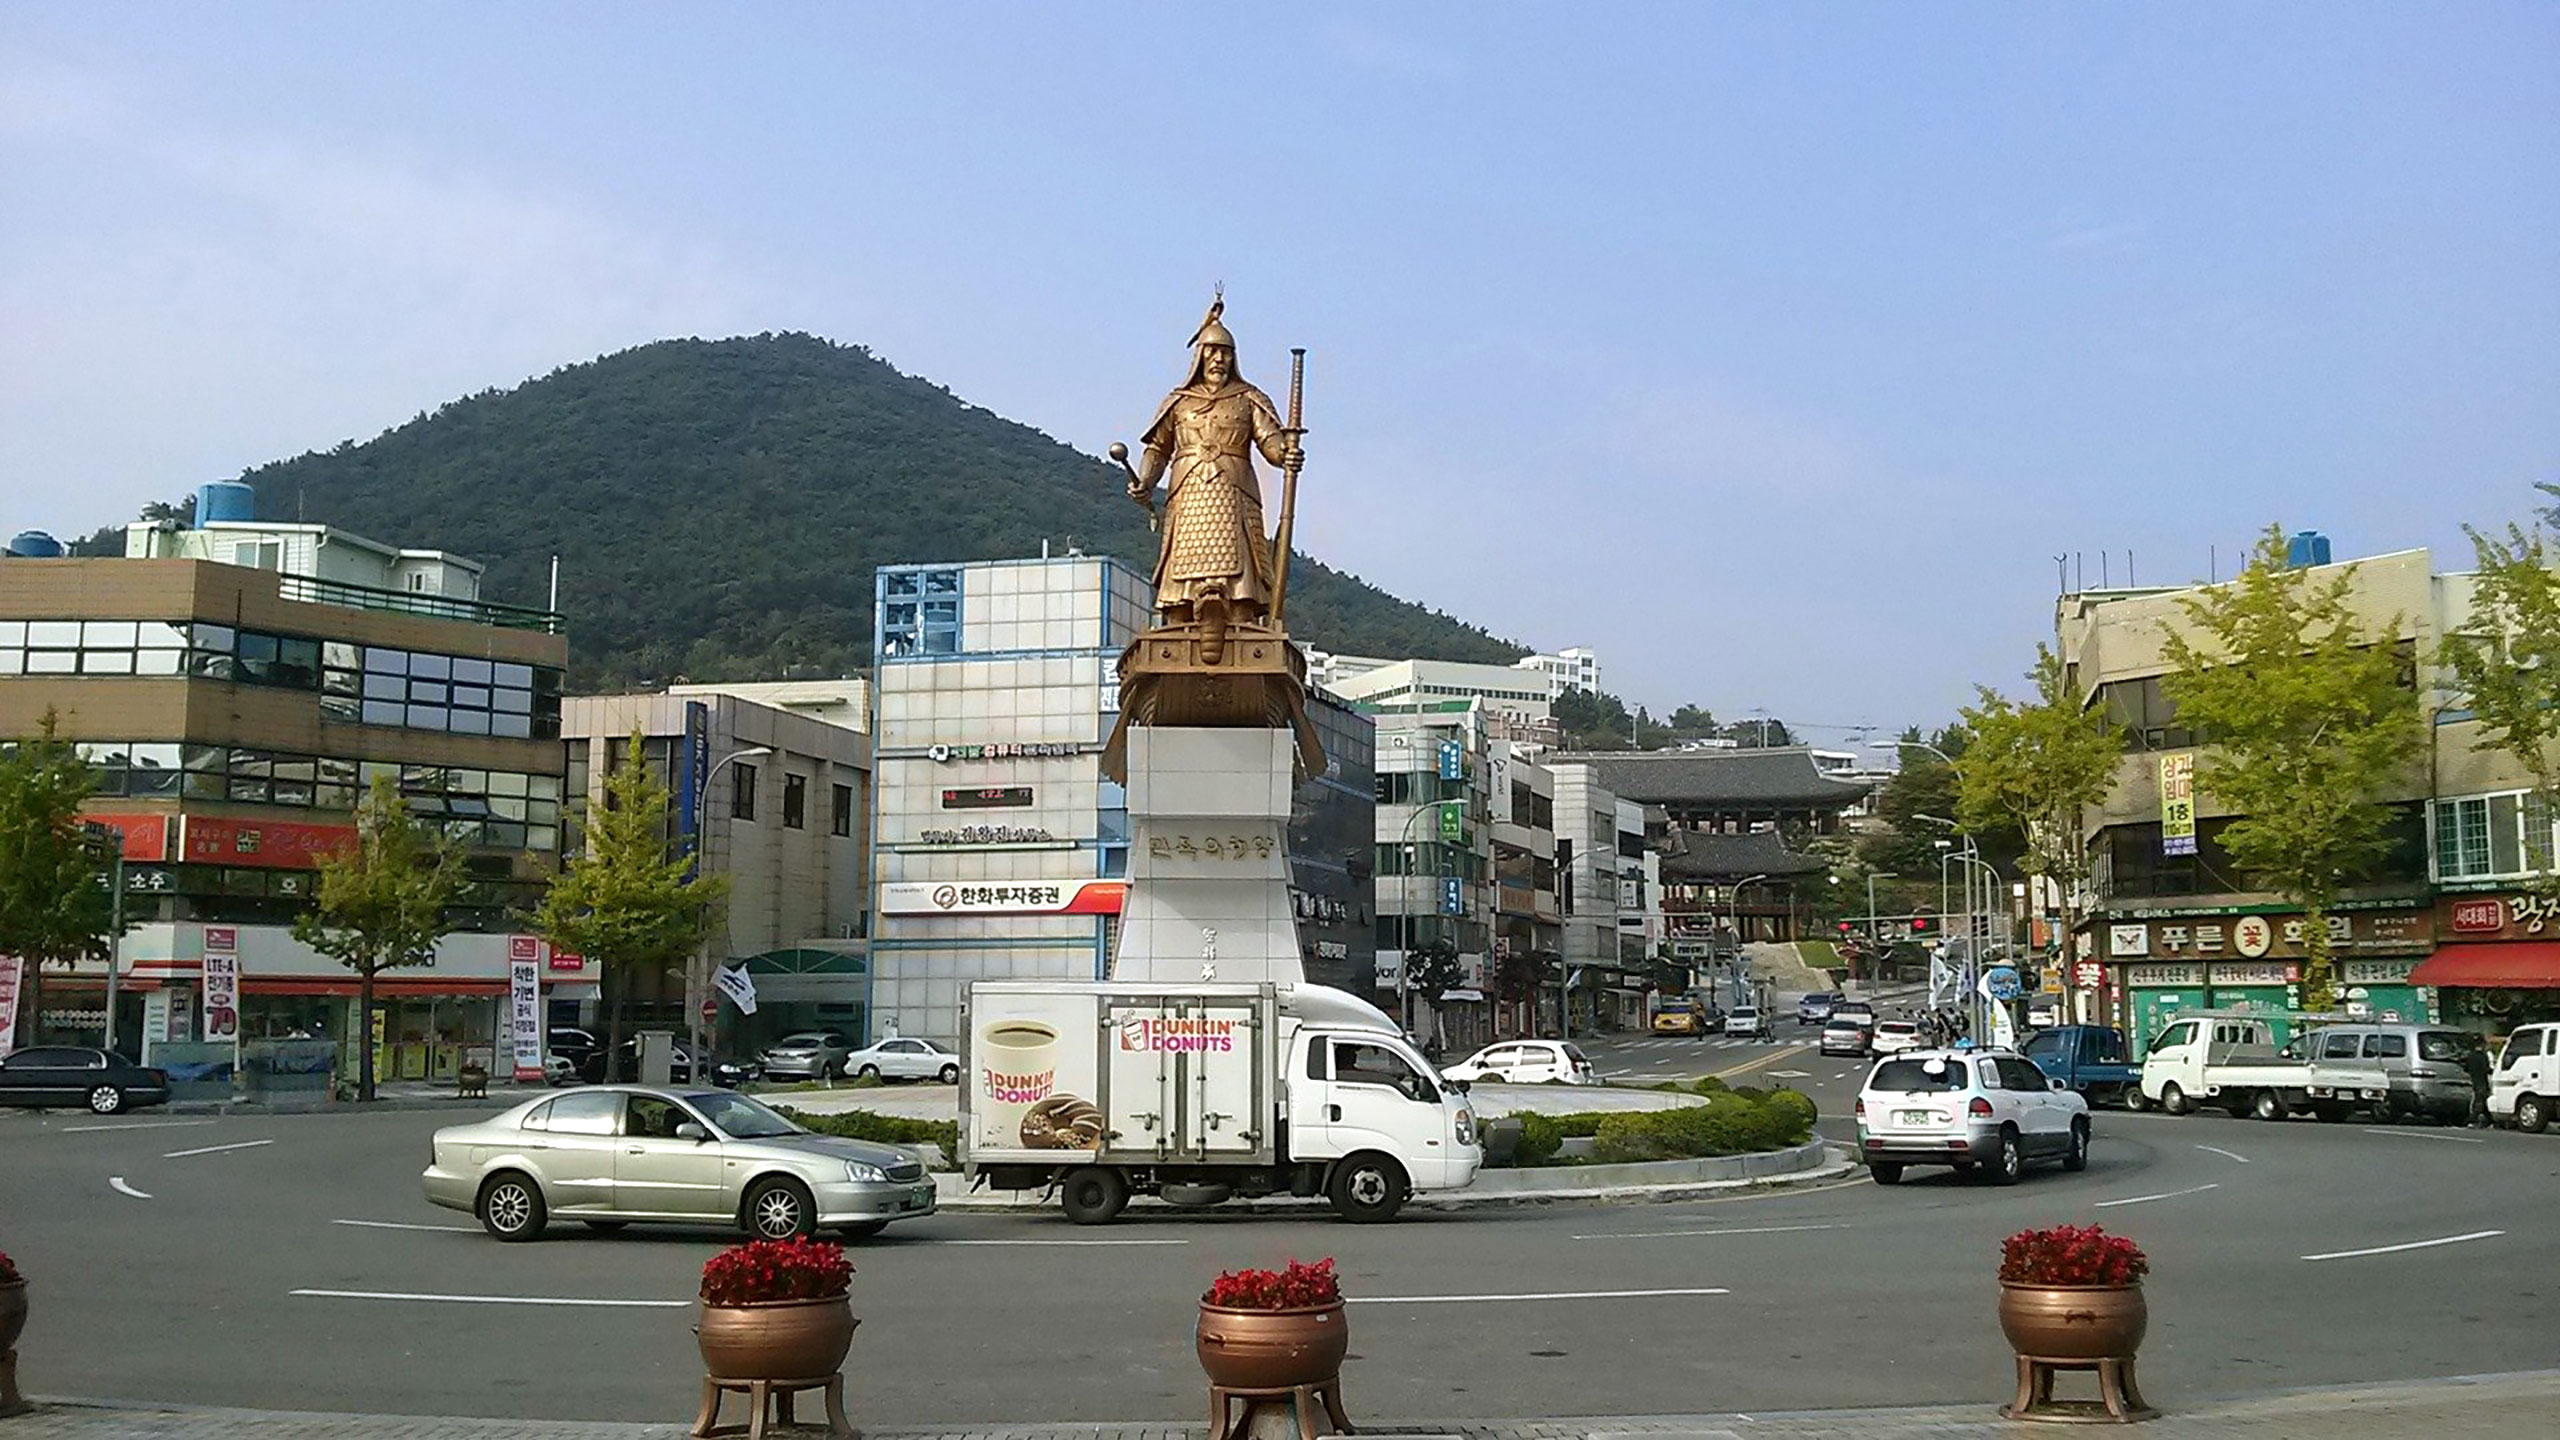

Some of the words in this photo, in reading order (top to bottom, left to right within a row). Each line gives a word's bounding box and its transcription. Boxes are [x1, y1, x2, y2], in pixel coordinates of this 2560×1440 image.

[2167, 803, 2189, 821] 1층
[128, 872, 165, 890] 소주
[960, 886, 1060, 904] 한화투자증권
[2161, 926, 2225, 951] 푸른
[2243, 925, 2262, 948] 꽃
[206, 958, 234, 973] LTE-A
[513, 966, 535, 982] 착한
[2076, 962, 2101, 987] 꽃
[514, 986, 535, 1001] 기변
[517, 1003, 531, 1017] 공식
[1152, 1020, 1236, 1035] DUNKIN'
[1152, 1036, 1232, 1051] DONUTS
